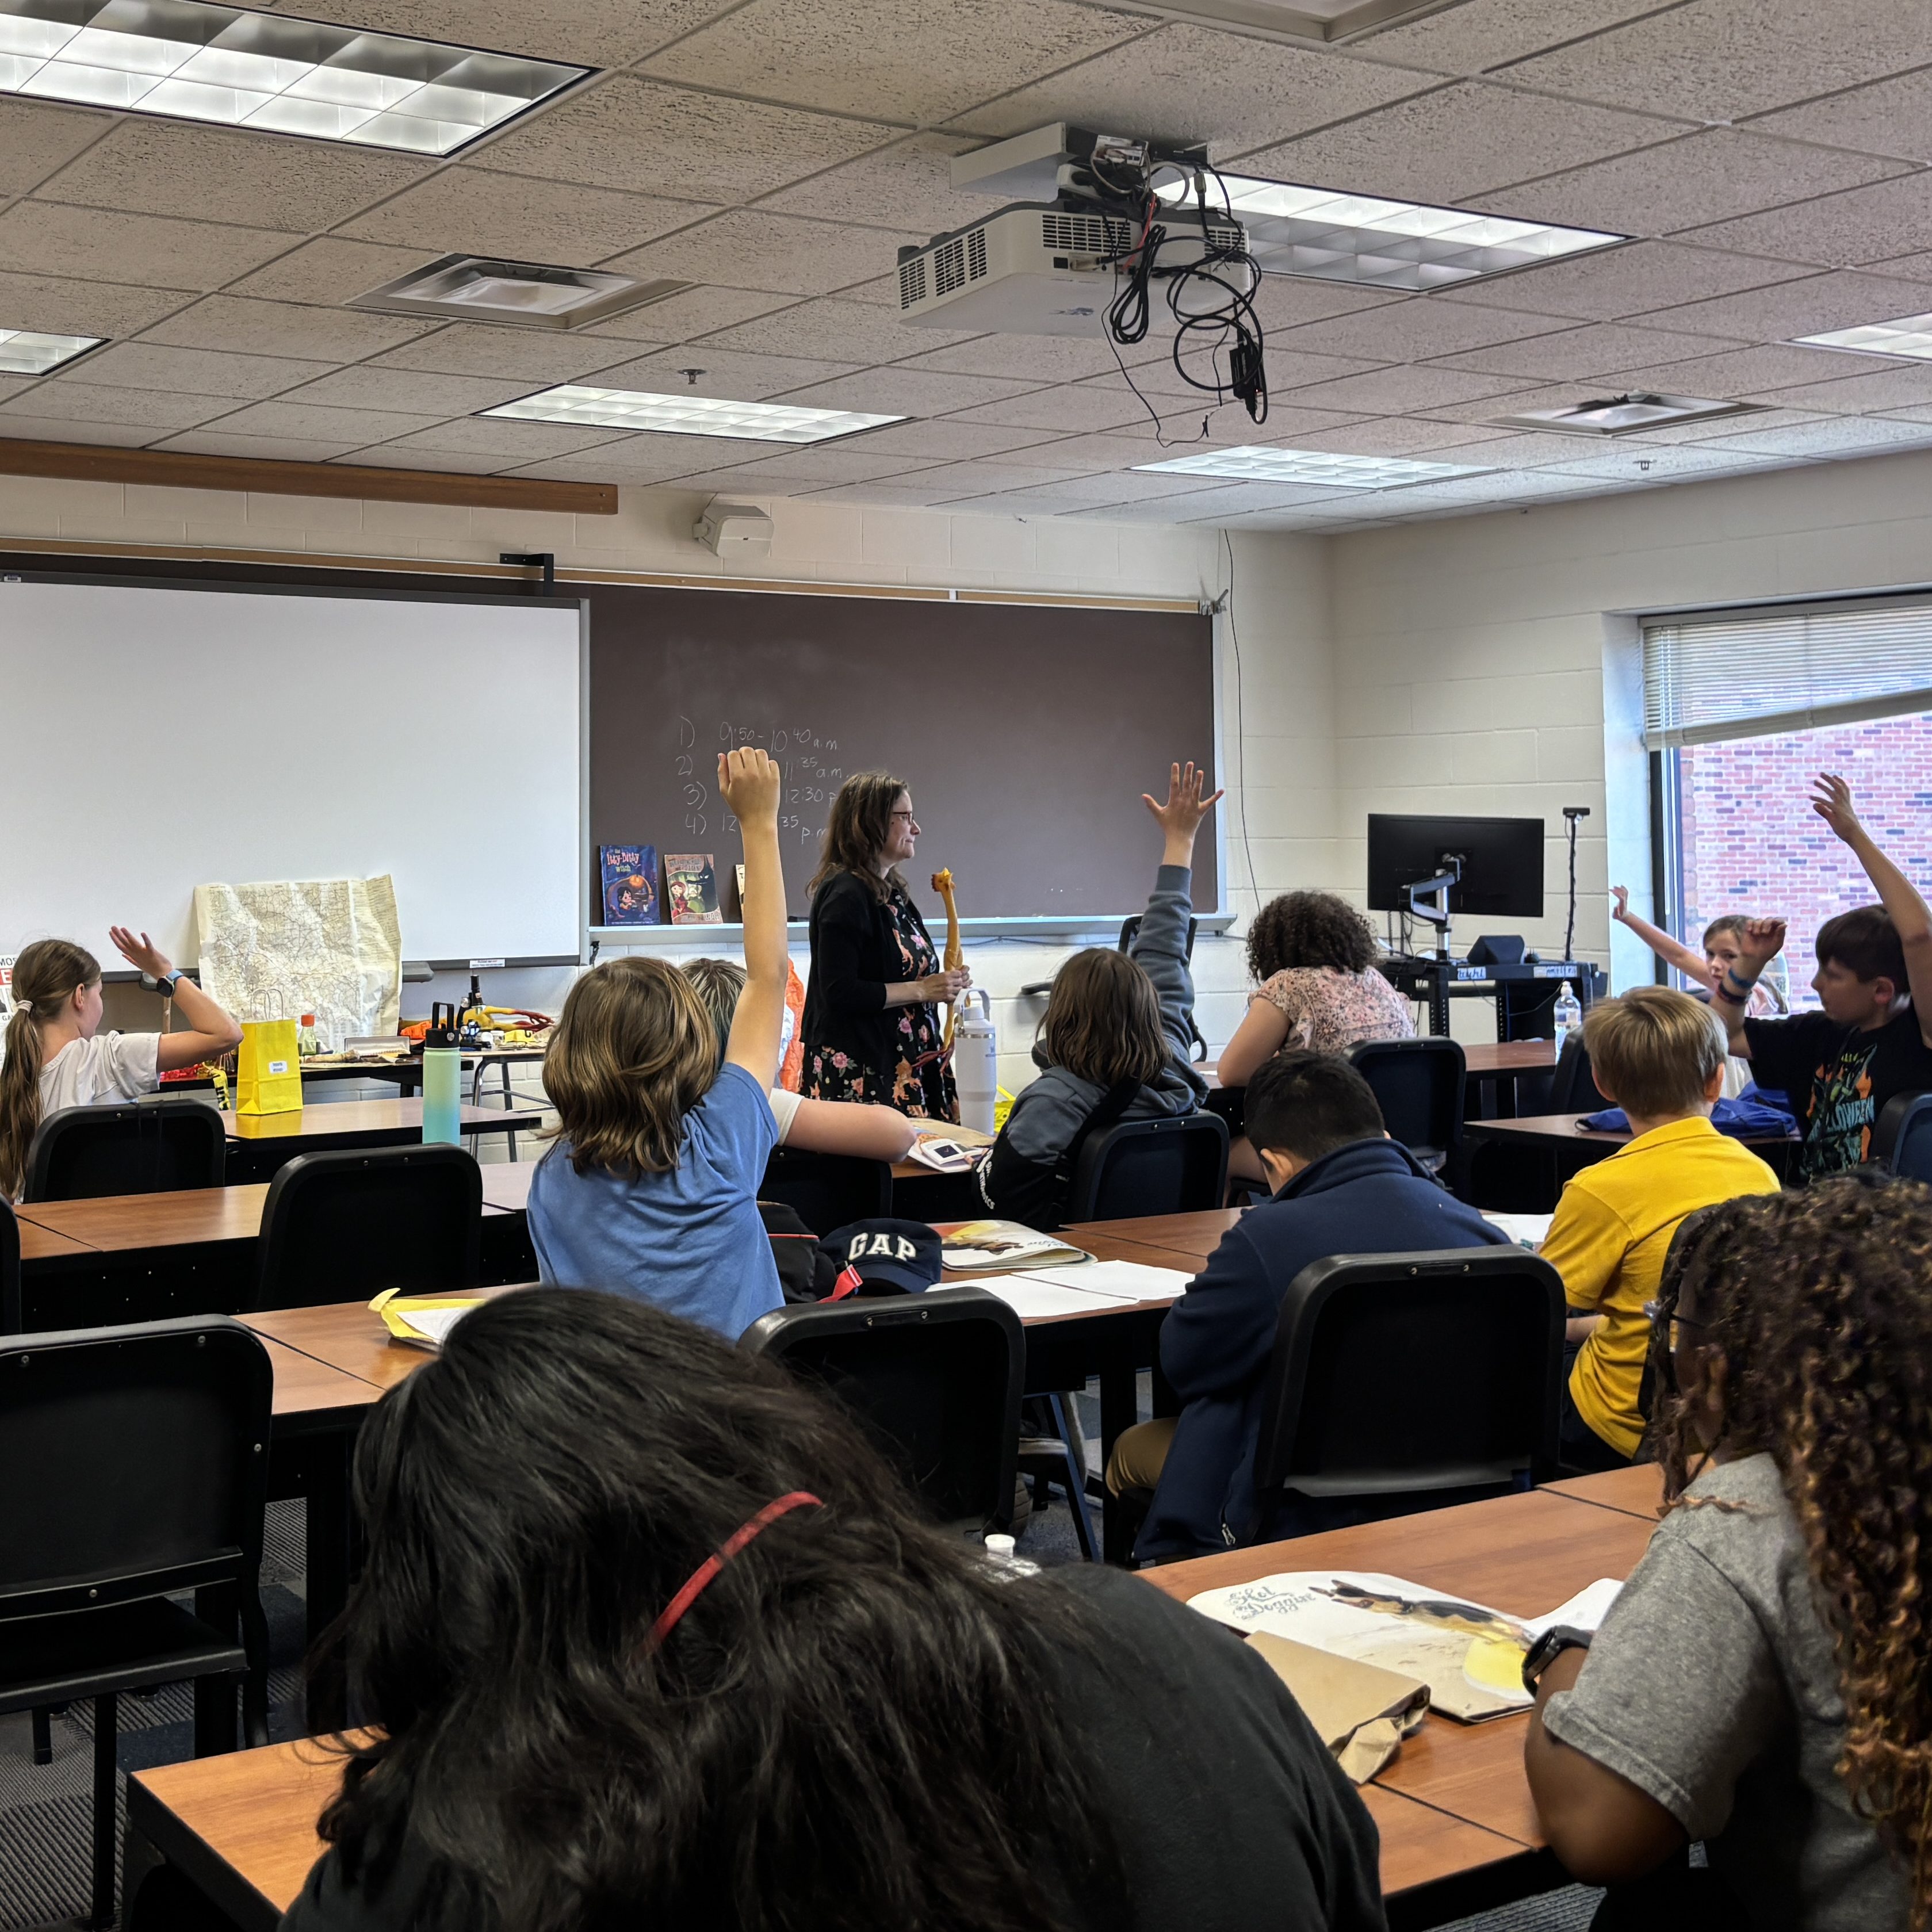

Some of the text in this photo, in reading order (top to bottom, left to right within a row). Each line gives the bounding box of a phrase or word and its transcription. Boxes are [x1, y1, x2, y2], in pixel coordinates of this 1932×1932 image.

[675, 754, 693, 775] 2)
[683, 781, 707, 810] 3)
[685, 813, 706, 835] 4)
[848, 1233, 916, 1261] GAP
